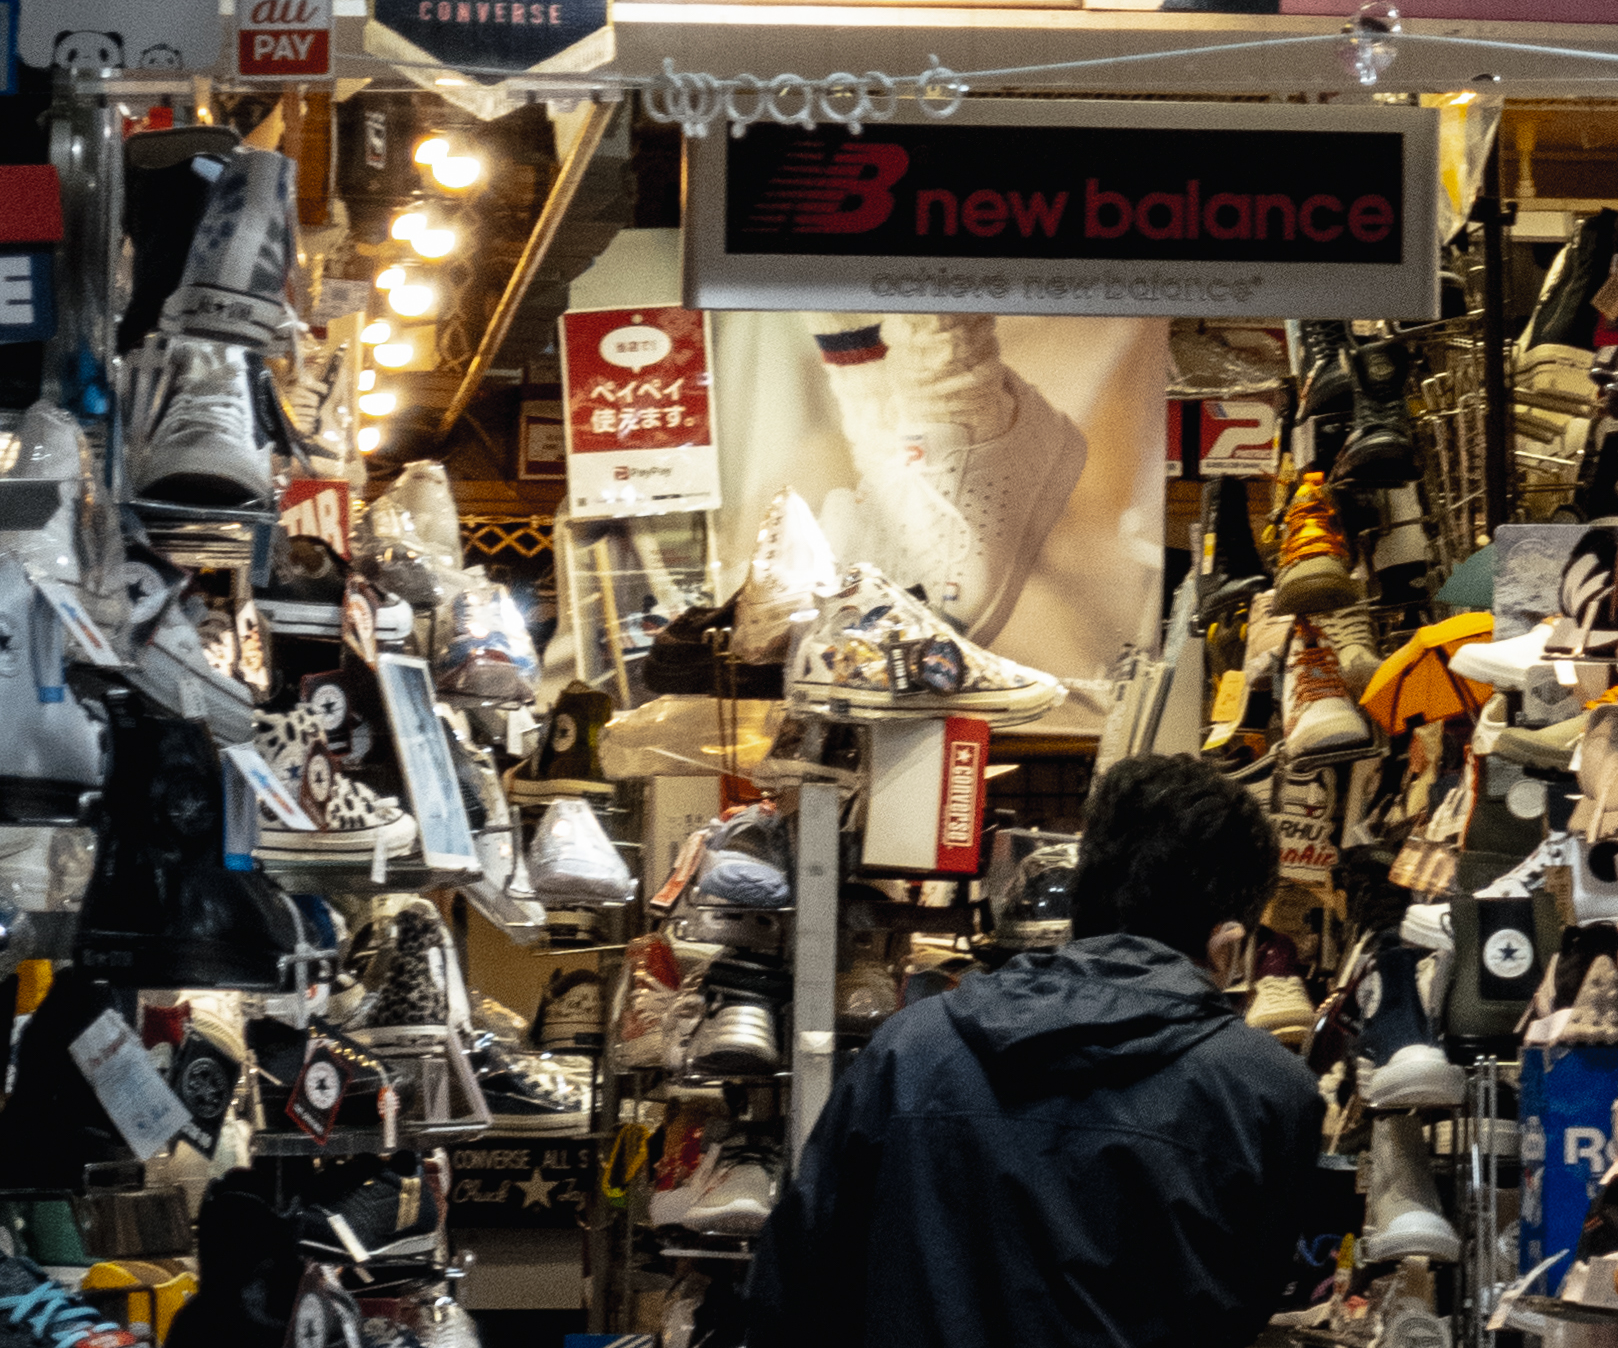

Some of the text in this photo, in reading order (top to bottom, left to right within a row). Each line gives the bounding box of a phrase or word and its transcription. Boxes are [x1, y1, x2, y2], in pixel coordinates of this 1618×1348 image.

[252, 0, 321, 25] au
[418, 1, 563, 24] CONVERSE
[253, 34, 315, 62] PAY
[914, 177, 1397, 243] new balance
[590, 378, 685, 403] ペイペイ
[590, 405, 696, 434] 使えます。
[945, 764, 973, 842] CONVERSE
[1272, 818, 1325, 842] RHU
[1280, 844, 1338, 866] nAir
[452, 1148, 532, 1171] CONVERSE
[540, 1148, 573, 1171] ALL
